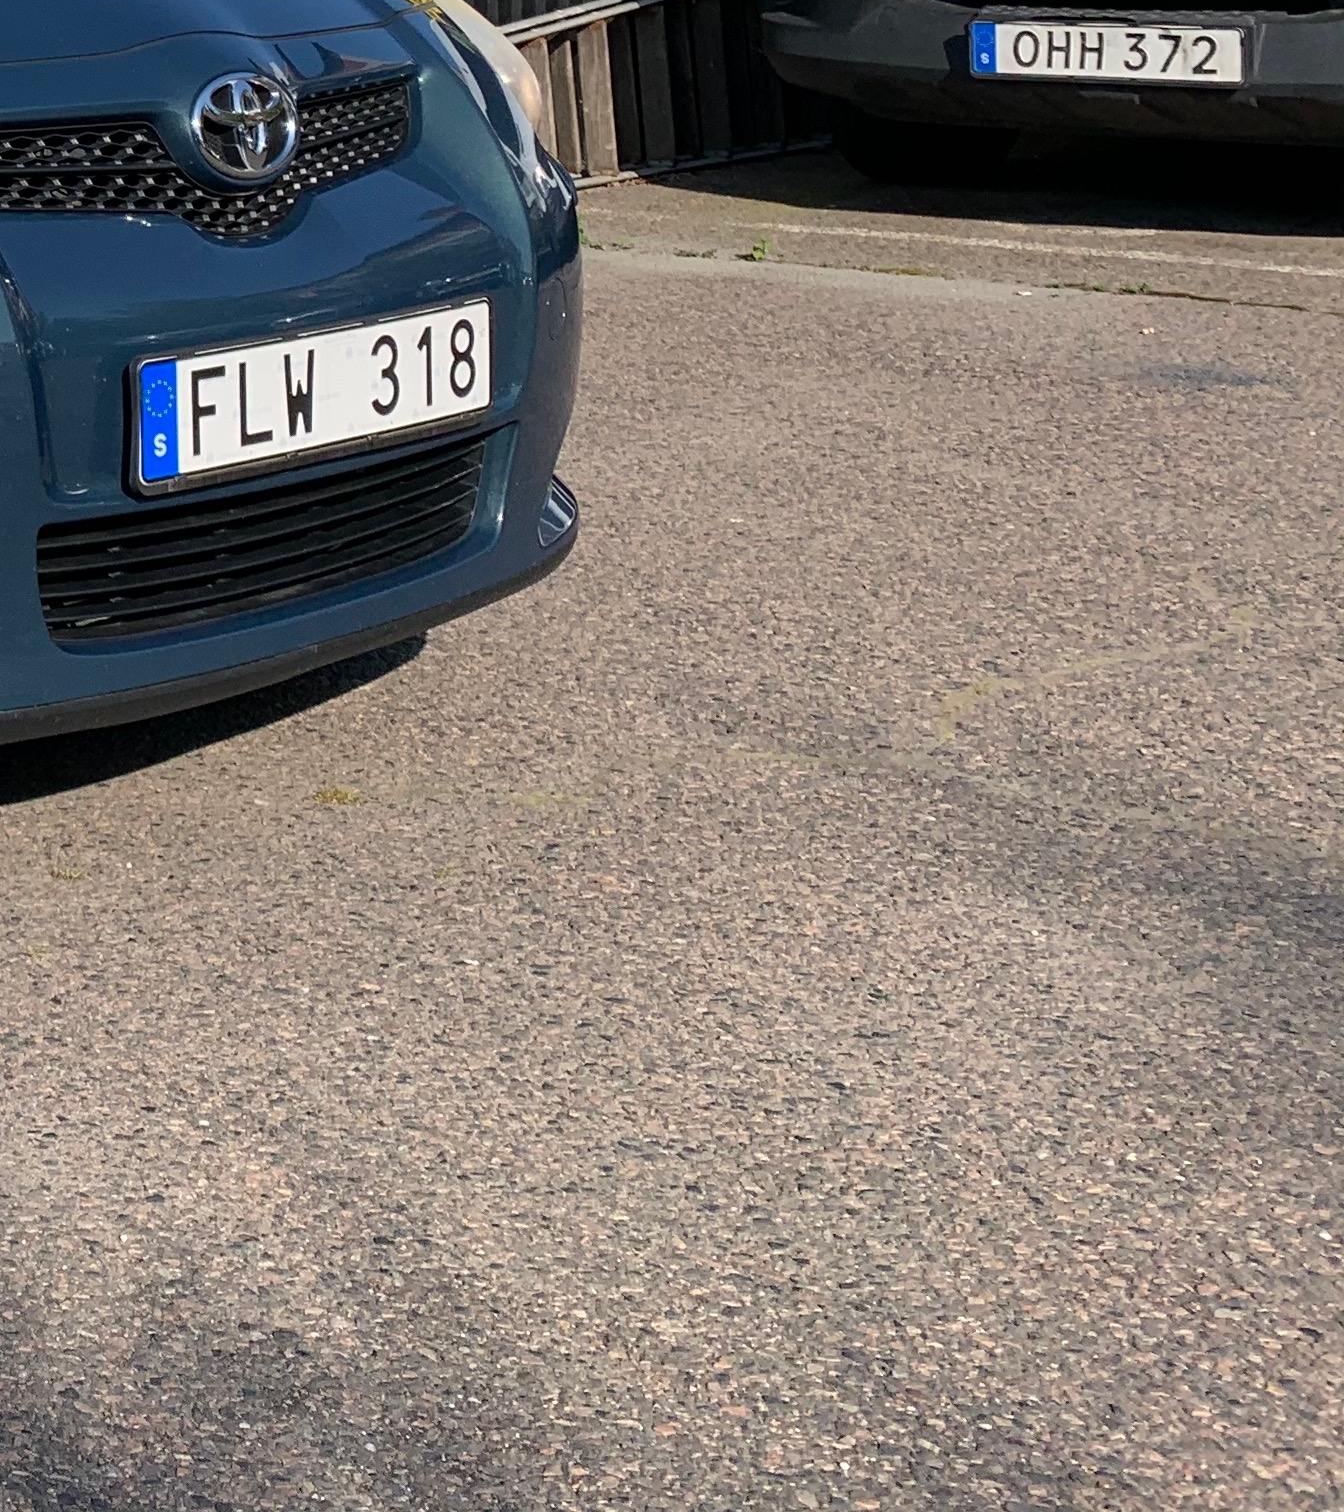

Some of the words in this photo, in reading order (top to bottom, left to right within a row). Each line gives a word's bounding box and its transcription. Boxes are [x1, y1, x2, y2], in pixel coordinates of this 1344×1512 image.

[980, 52, 990, 65] S
[1012, 30, 1104, 70] OHH
[1123, 33, 1218, 75] 372
[190, 348, 315, 456] FLW
[370, 318, 477, 417] 318
[153, 432, 167, 458] S
